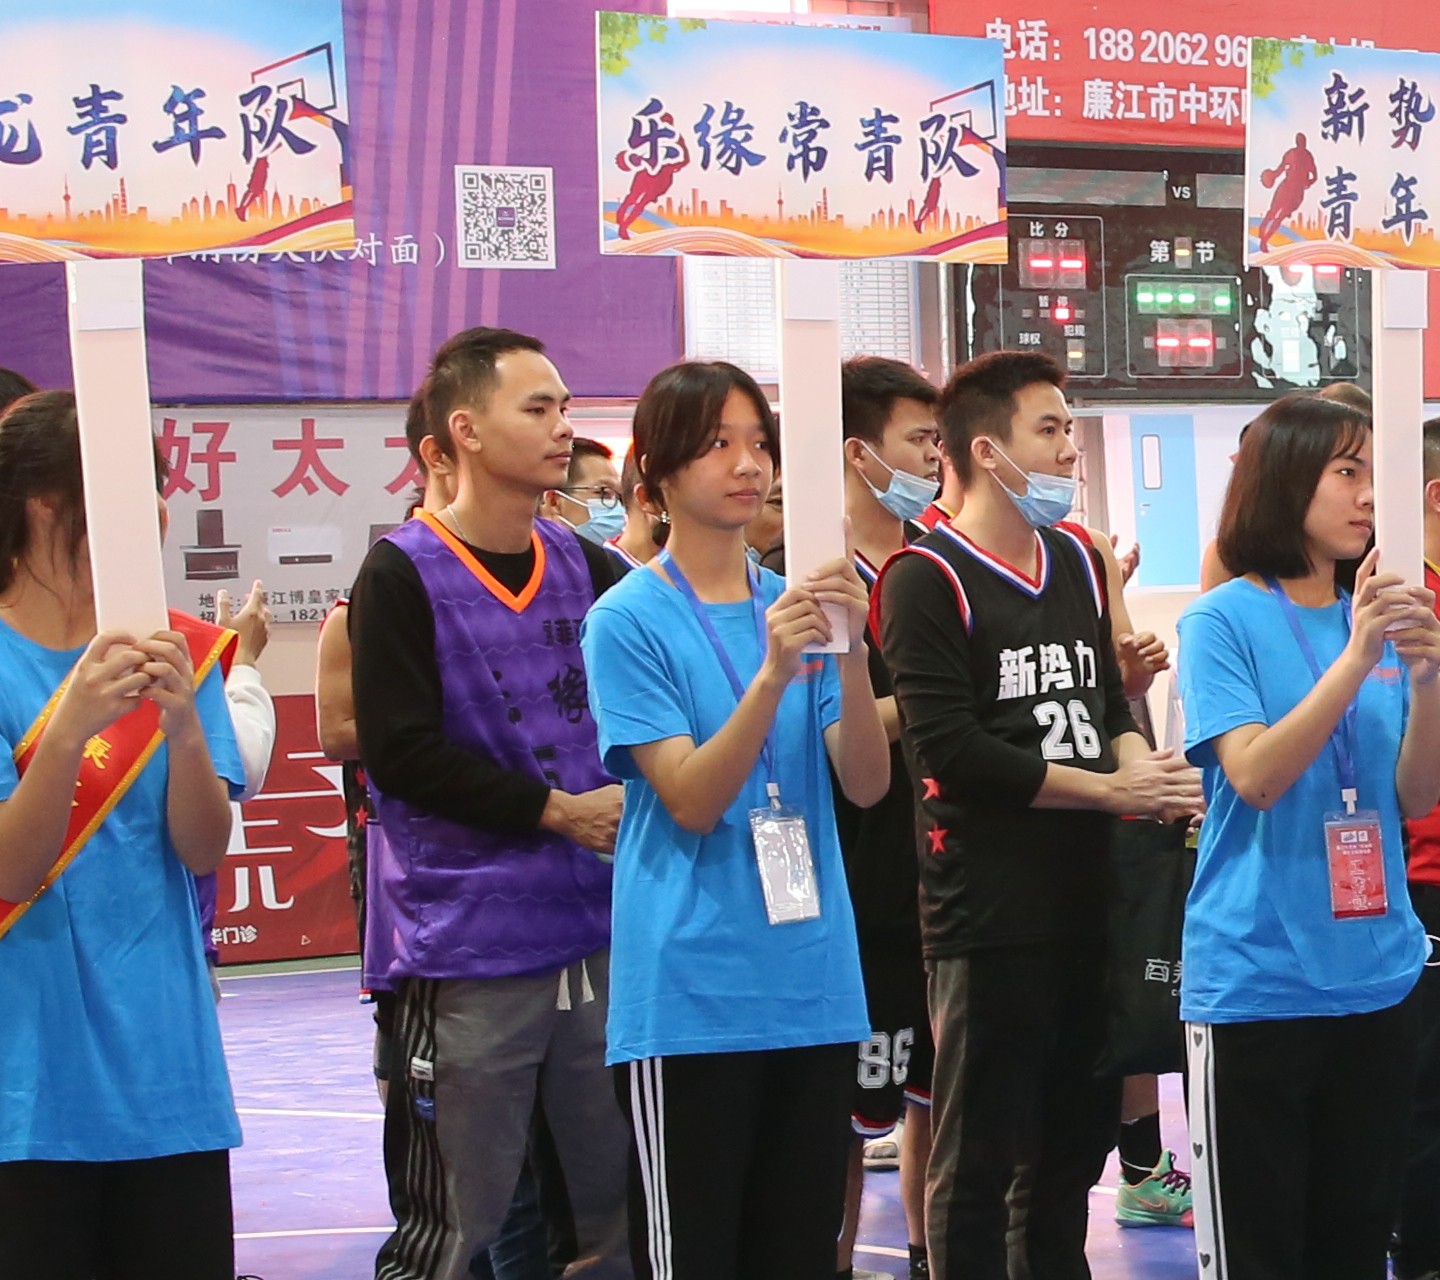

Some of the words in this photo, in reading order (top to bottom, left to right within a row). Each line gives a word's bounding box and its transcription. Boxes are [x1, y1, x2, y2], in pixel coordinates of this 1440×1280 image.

[1140, 29, 1210, 66] 2062
[625, 98, 982, 184] 乐缘常青队
[1171, 185, 1192, 200] VS
[1029, 221, 1070, 239] 比分
[998, 641, 1098, 703] 新势力
[1033, 698, 1102, 761] 26
